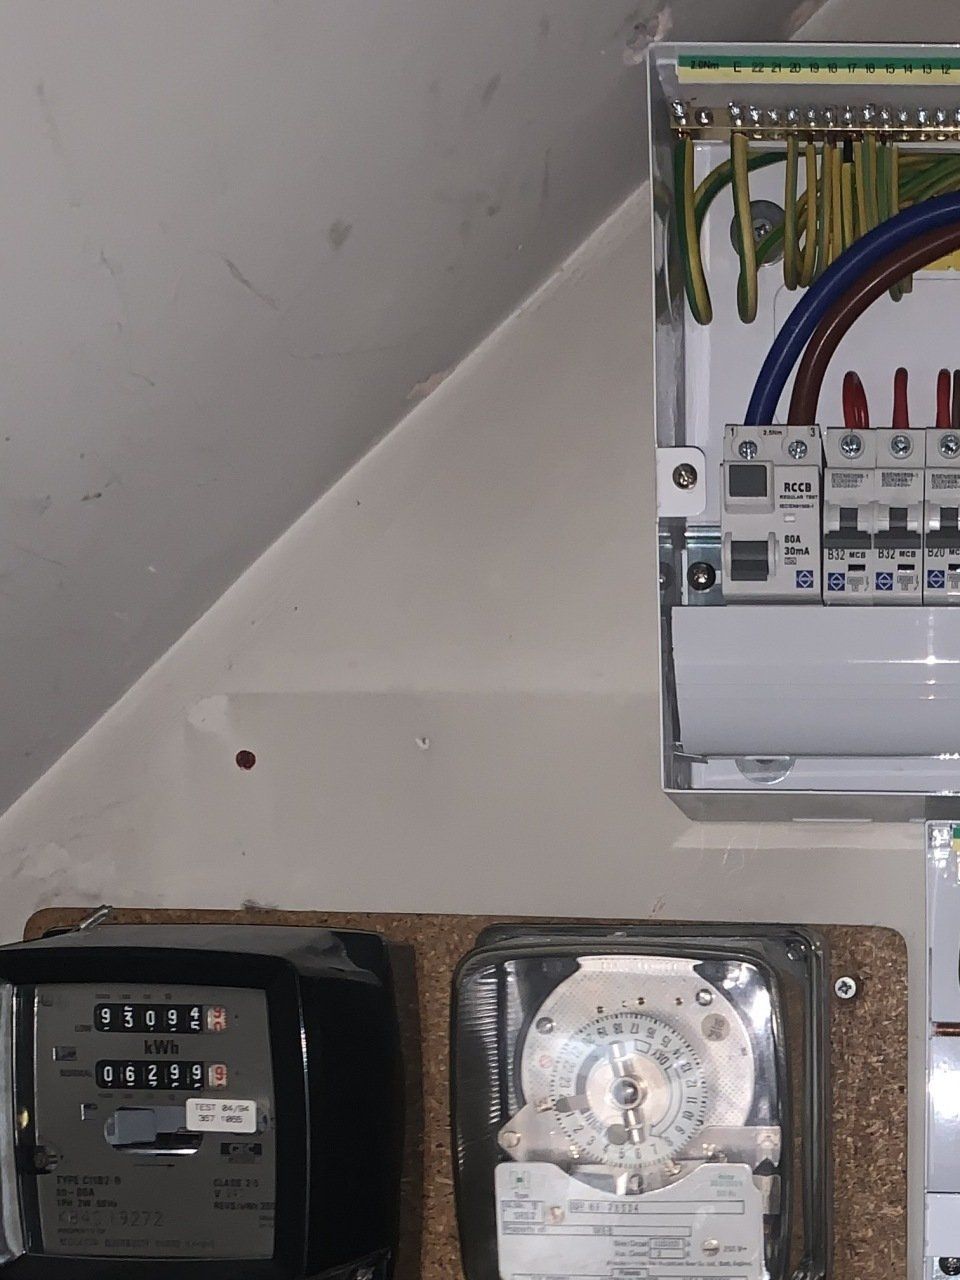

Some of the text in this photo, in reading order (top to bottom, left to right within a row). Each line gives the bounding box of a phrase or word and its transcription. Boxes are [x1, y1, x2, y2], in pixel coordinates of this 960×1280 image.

[734, 62, 741, 72] E
[752, 62, 764, 72] 22
[772, 62, 782, 72] 21
[790, 62, 800, 73] 20
[810, 62, 820, 73] 19
[828, 62, 838, 73] 18
[848, 63, 857, 73] 17
[866, 63, 876, 73] 16
[886, 63, 895, 74] 15
[904, 63, 912, 74] 14
[922, 64, 932, 74] 13
[942, 64, 950, 74] 12
[784, 482, 811, 492] RCCB
[784, 547, 810, 555] 30mA
[828, 549, 845, 560] B32
[878, 549, 895, 559] B32
[928, 549, 945, 557] B20
[144, 1040, 179, 1055] kWh
[195, 1103, 216, 1111] TEST
[56, 1176, 79, 1184] TYPE
